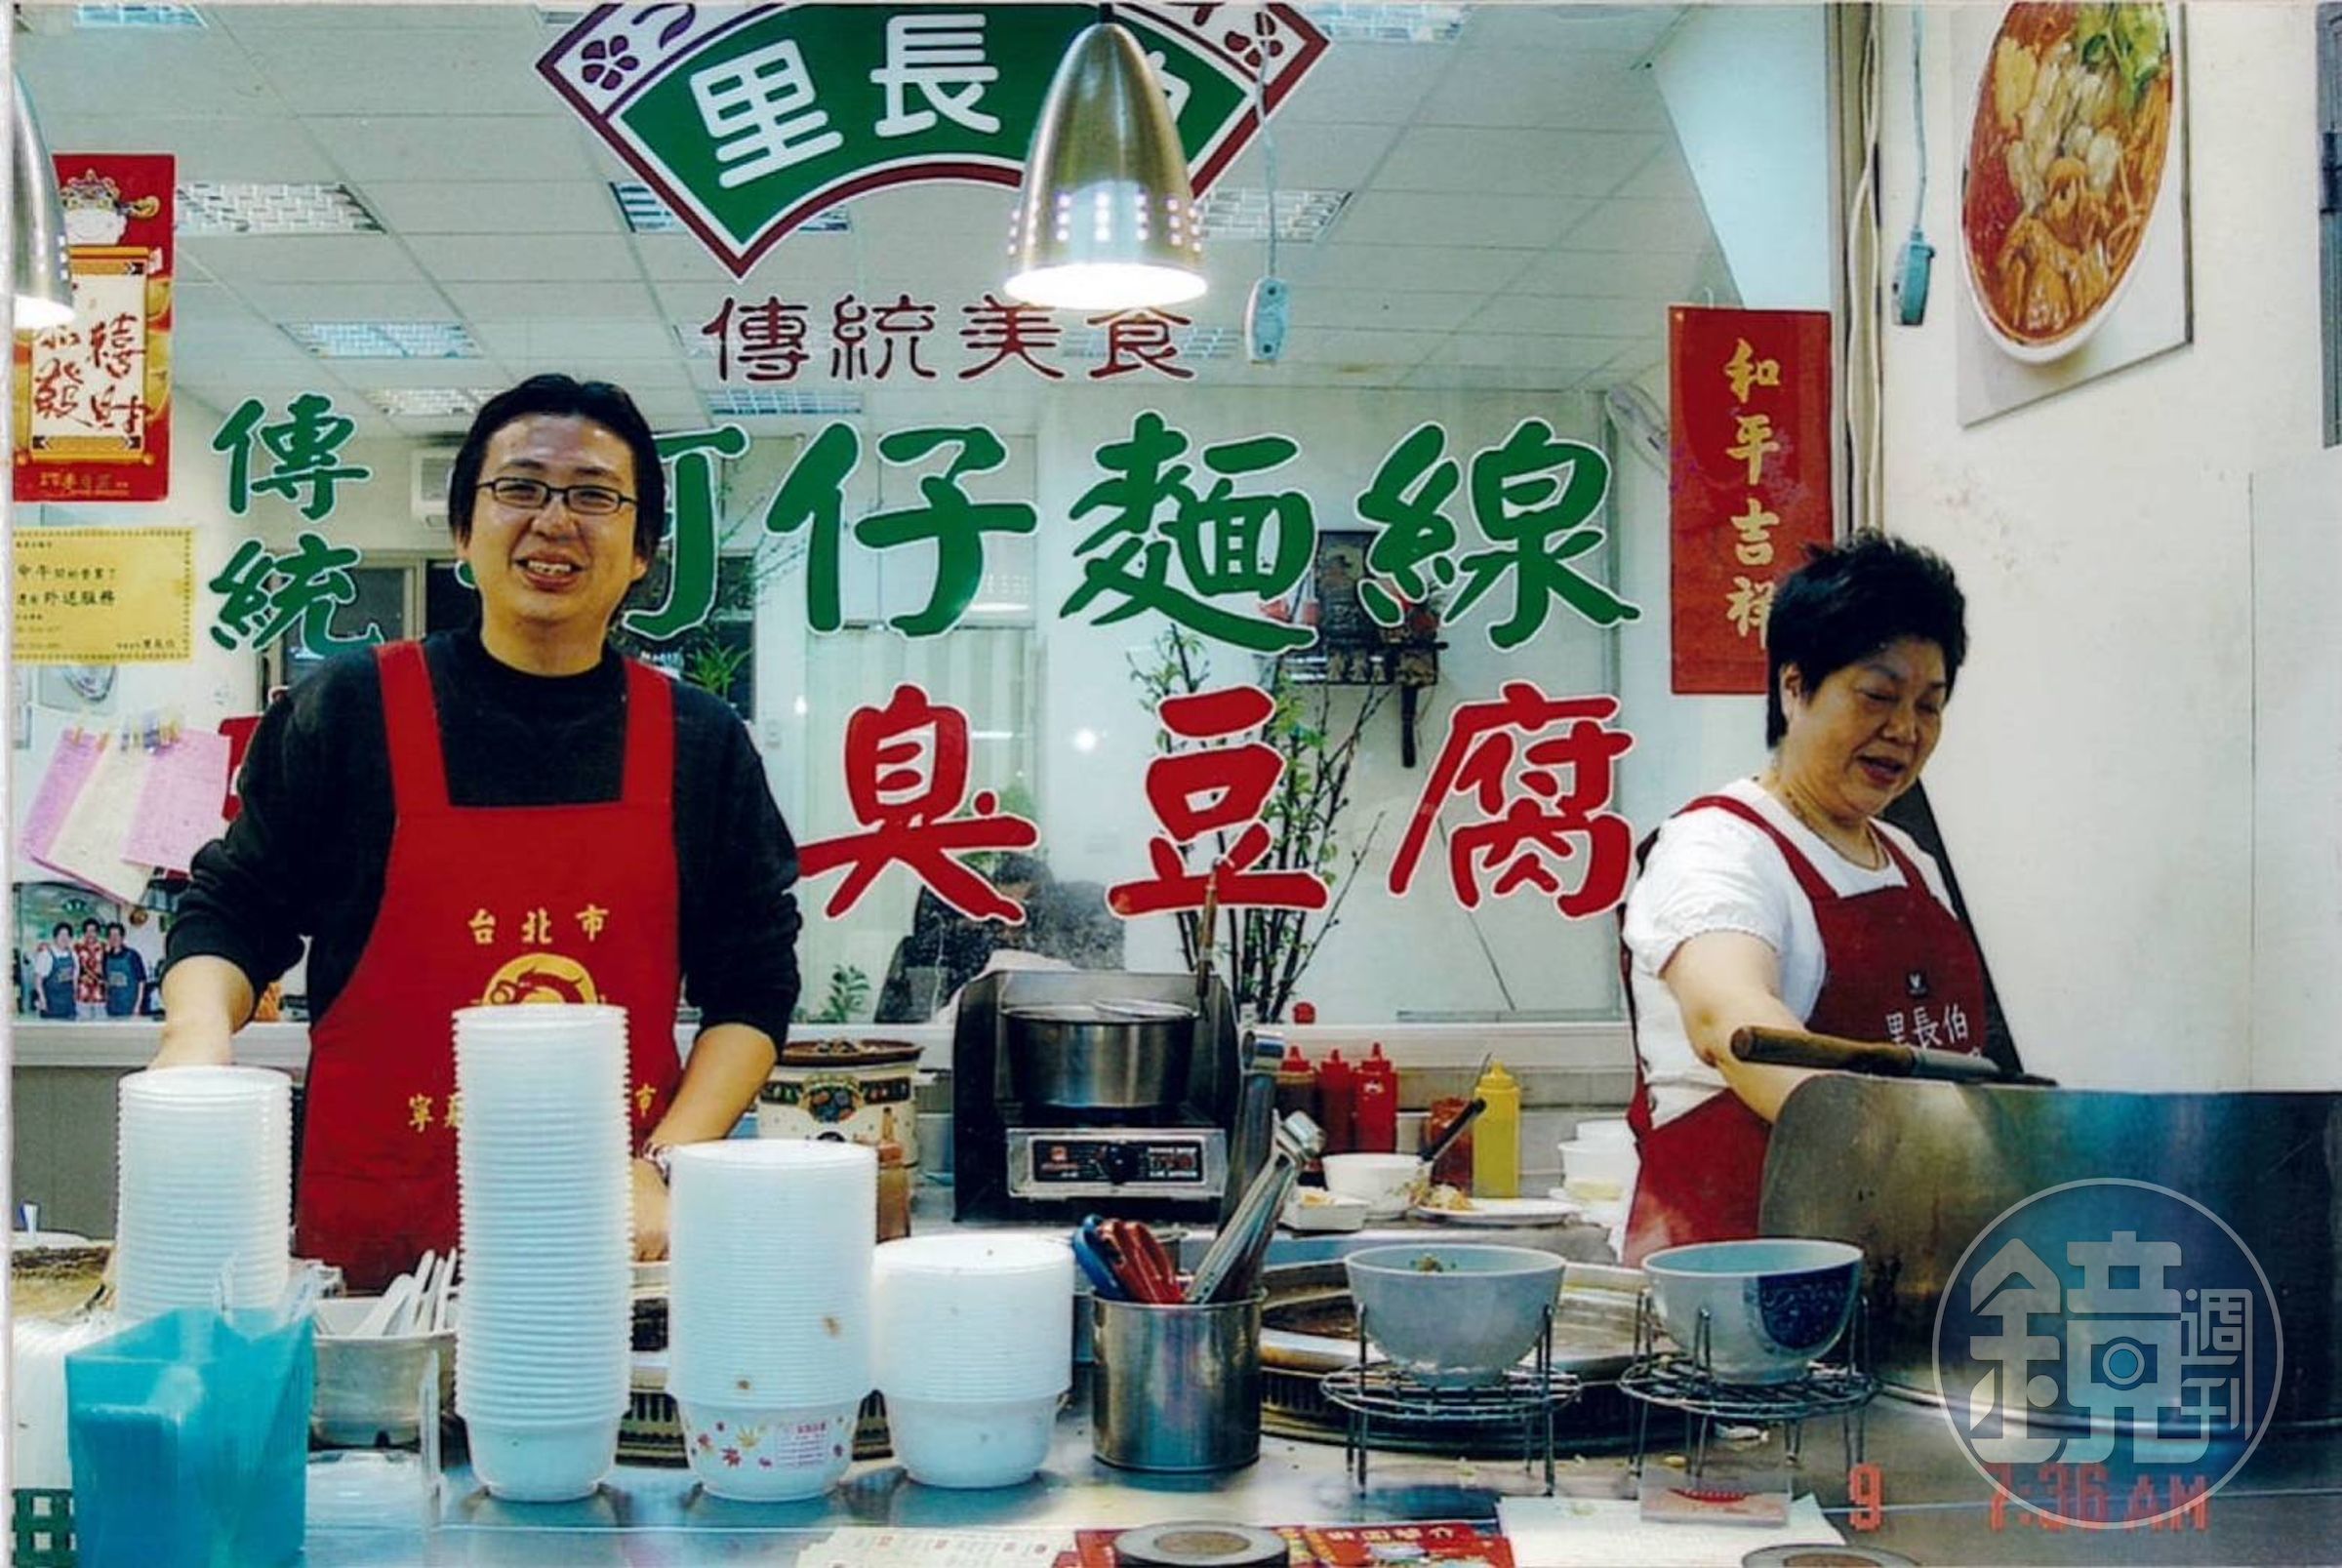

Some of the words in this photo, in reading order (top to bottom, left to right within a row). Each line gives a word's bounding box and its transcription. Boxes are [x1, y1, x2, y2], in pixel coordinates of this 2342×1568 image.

[689, 13, 1191, 189] 里長
[702, 294, 1194, 381] 傳統美食
[208, 394, 383, 652] 傳統
[797, 681, 1635, 925] 臭豆腐
[467, 904, 610, 945] 台北市
[1885, 1002, 1969, 1050] 里長伯
